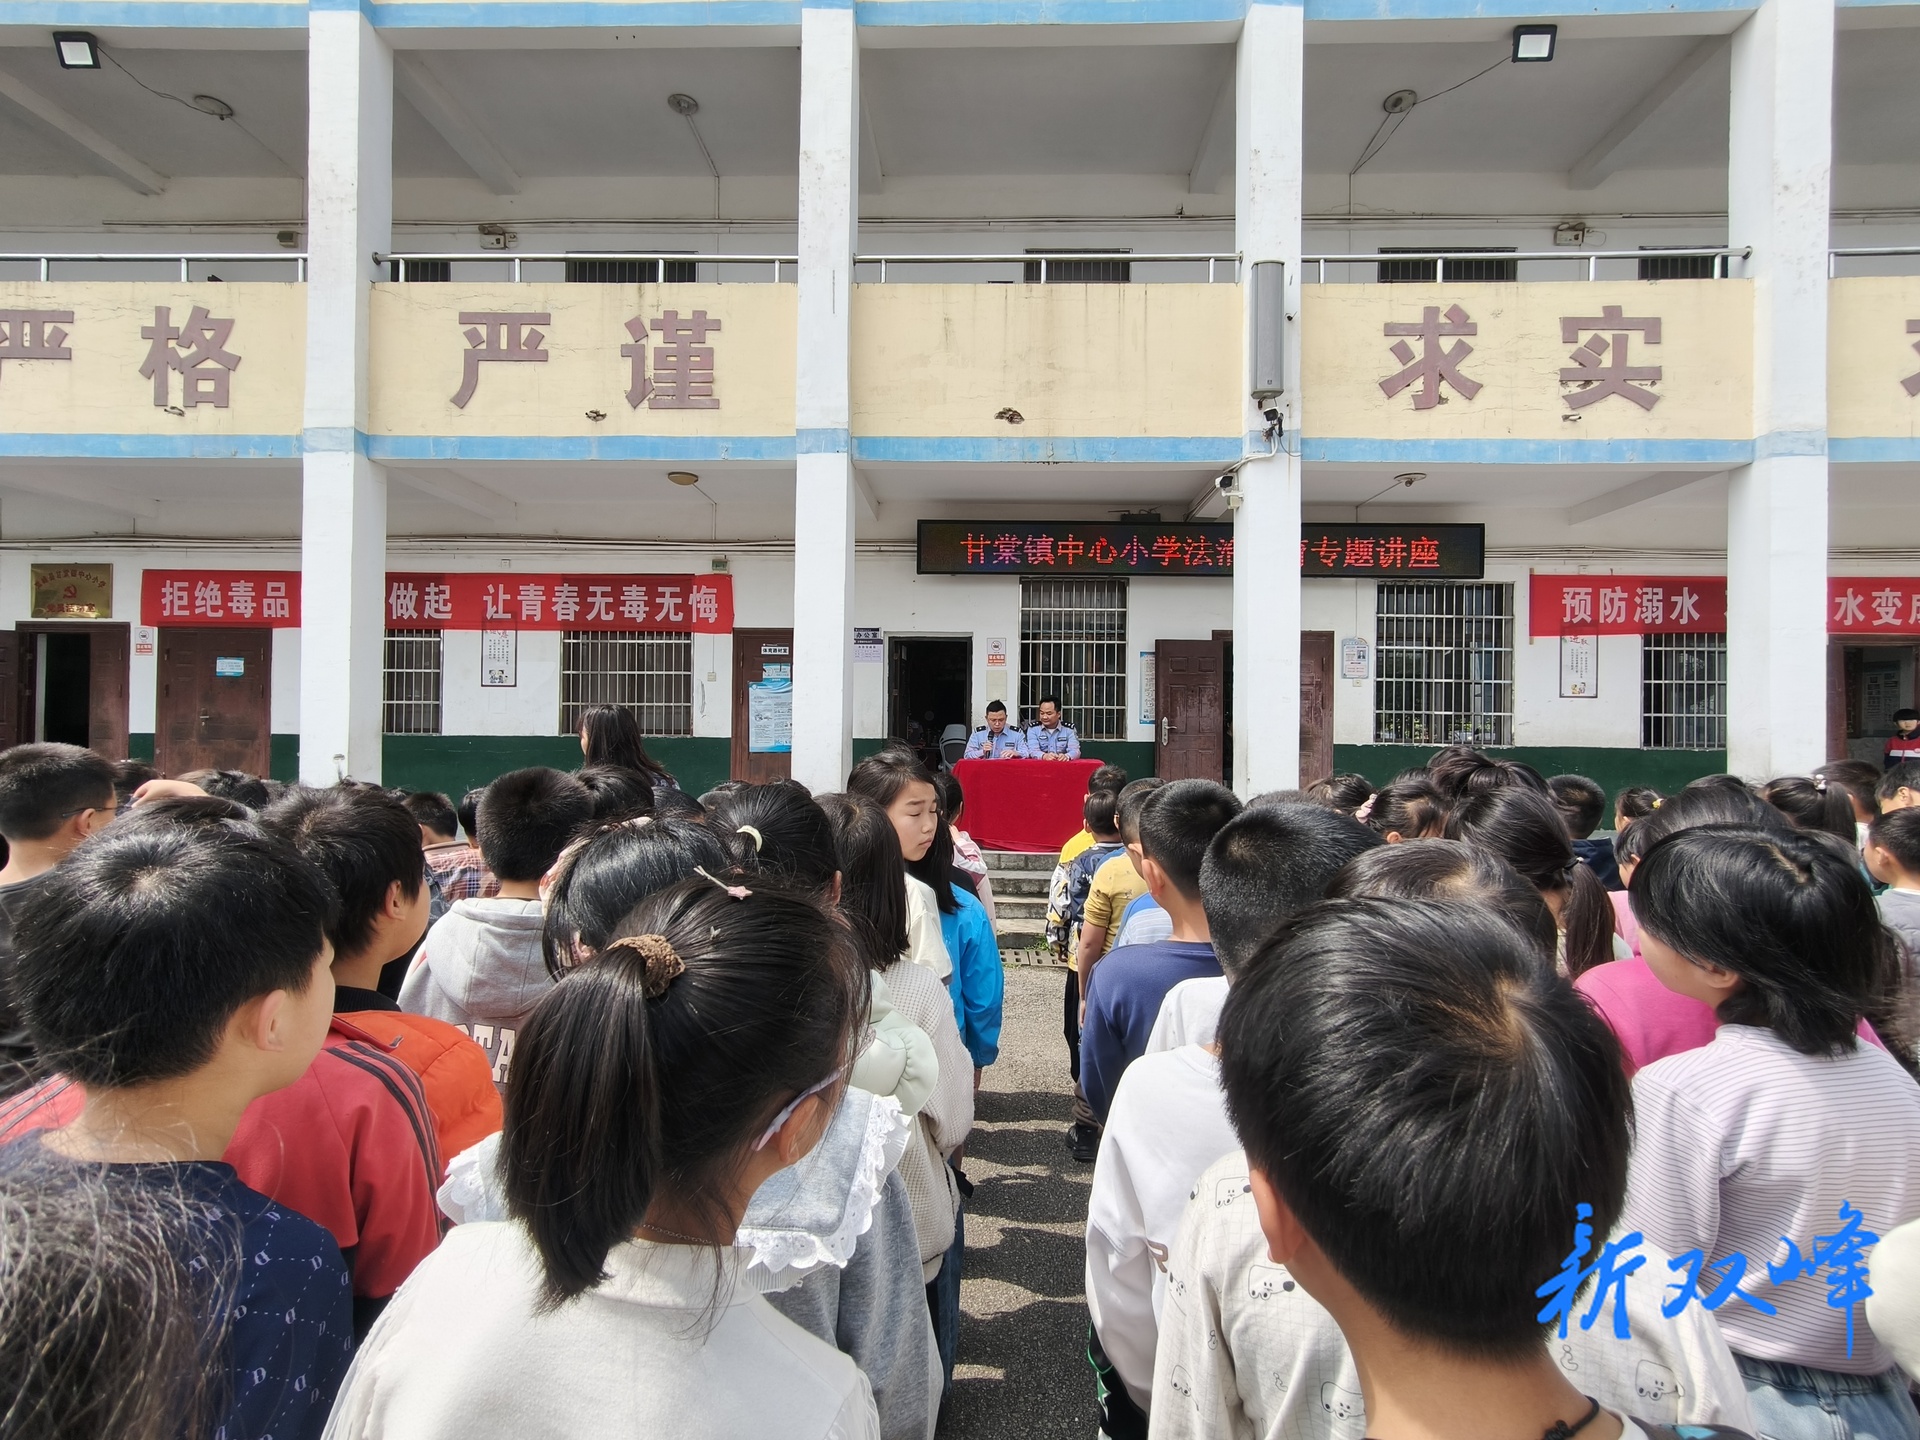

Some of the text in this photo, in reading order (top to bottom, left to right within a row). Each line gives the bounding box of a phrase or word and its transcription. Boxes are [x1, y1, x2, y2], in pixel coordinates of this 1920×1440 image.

[450, 308, 722, 411] 严谨
[1378, 303, 1663, 411] 求实
[160, 579, 719, 624] 拒绝毒品 做起 让青春无毒无悔
[1561, 585, 1700, 625] 预防溺水
